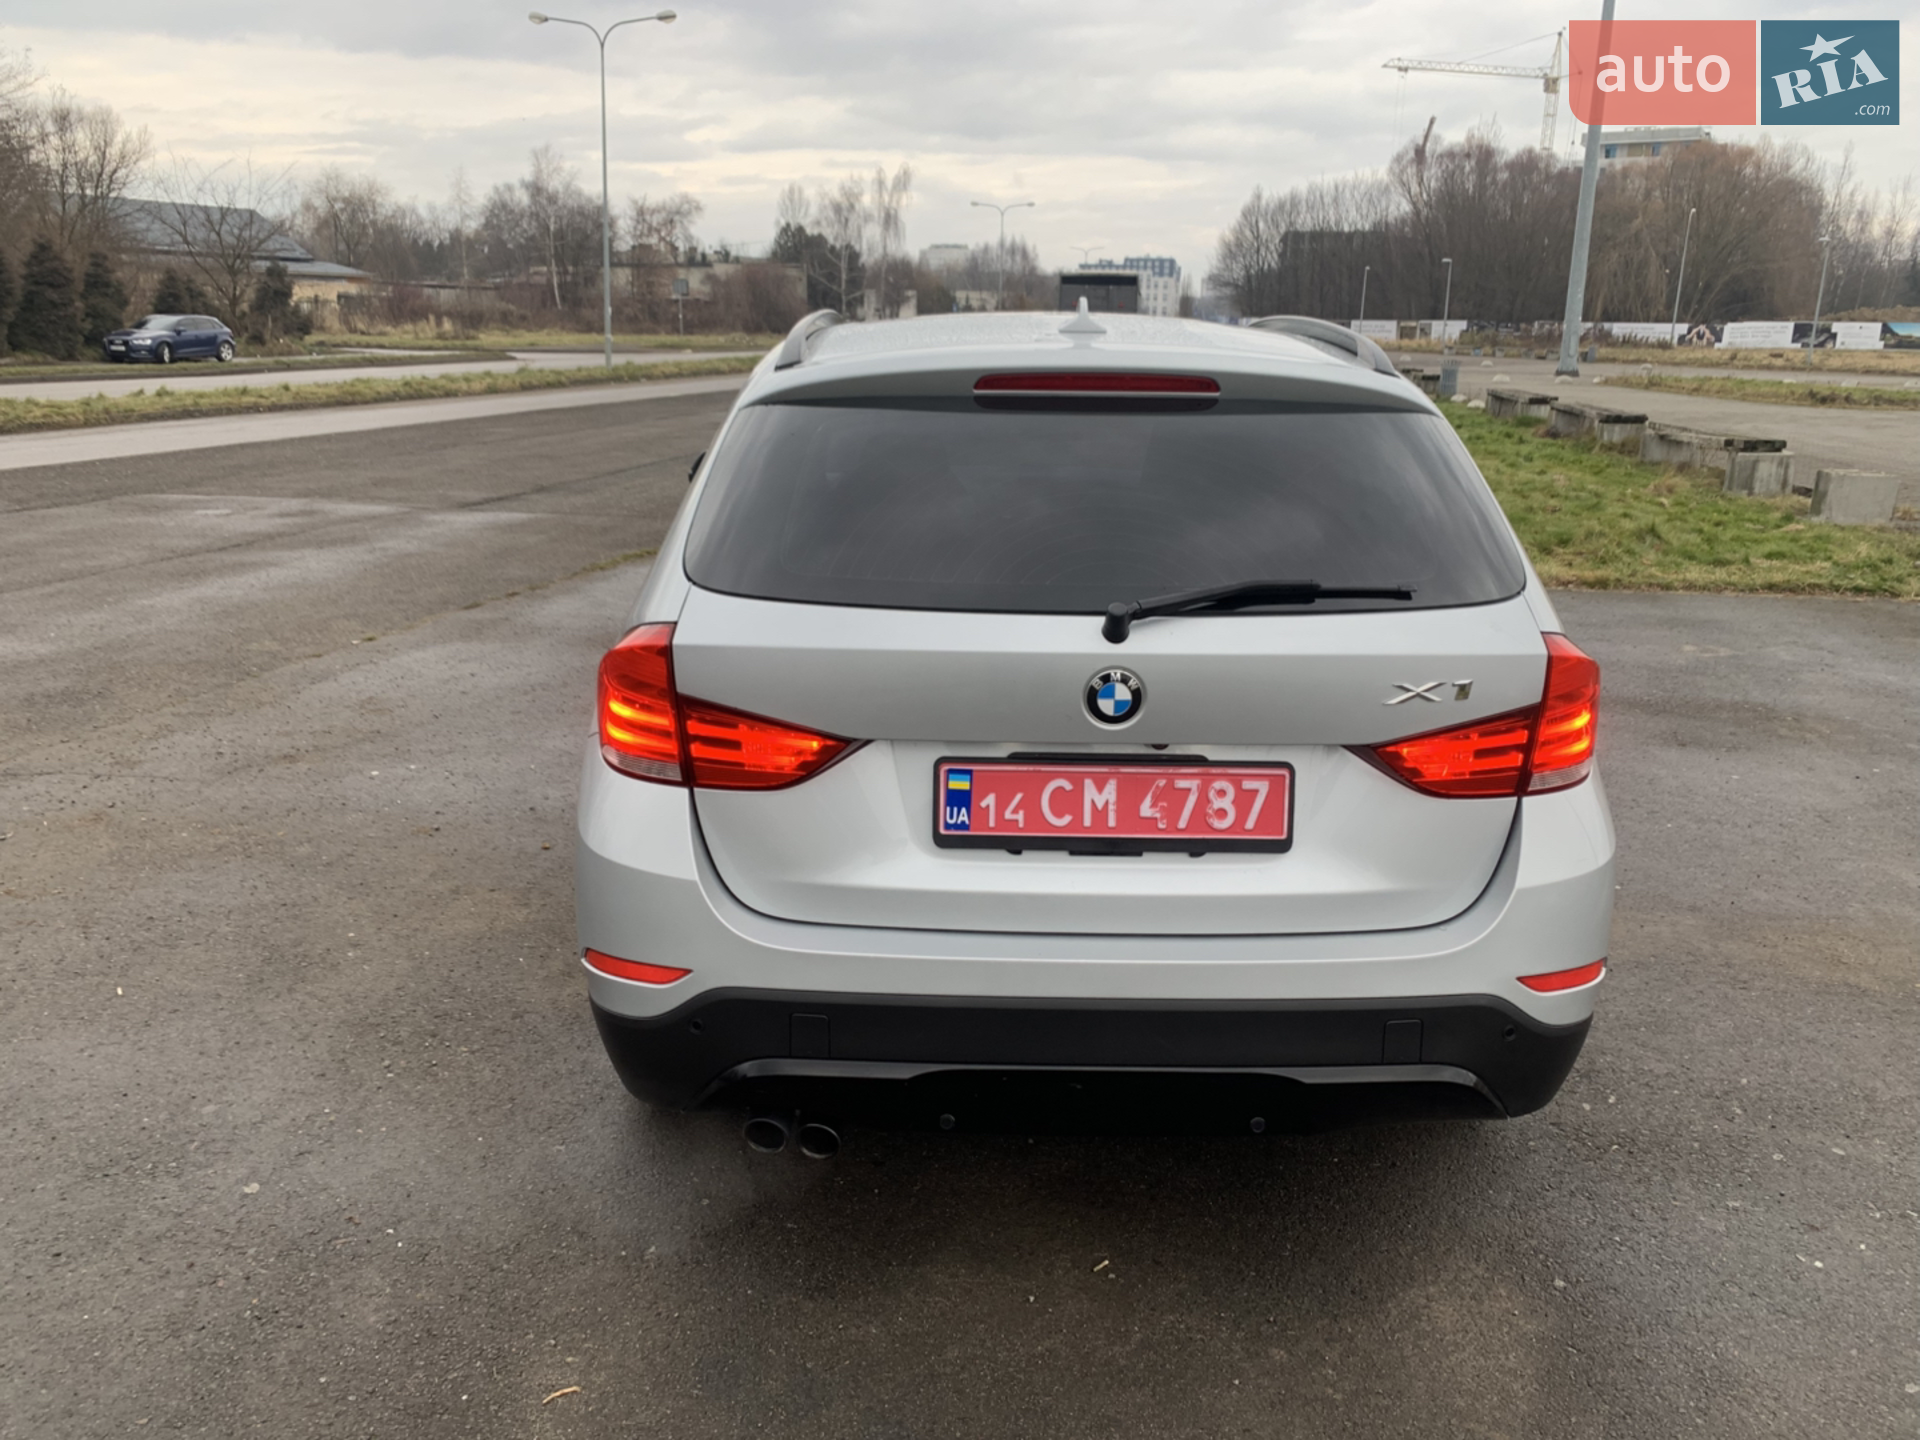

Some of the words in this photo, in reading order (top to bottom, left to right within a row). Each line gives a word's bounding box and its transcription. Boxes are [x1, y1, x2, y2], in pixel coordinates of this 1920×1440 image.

[1382, 679, 1474, 706] X1
[946, 806, 970, 825] UA
[979, 792, 1025, 828] 14
[1040, 778, 1117, 828] CM
[1139, 779, 1270, 830] 4787
